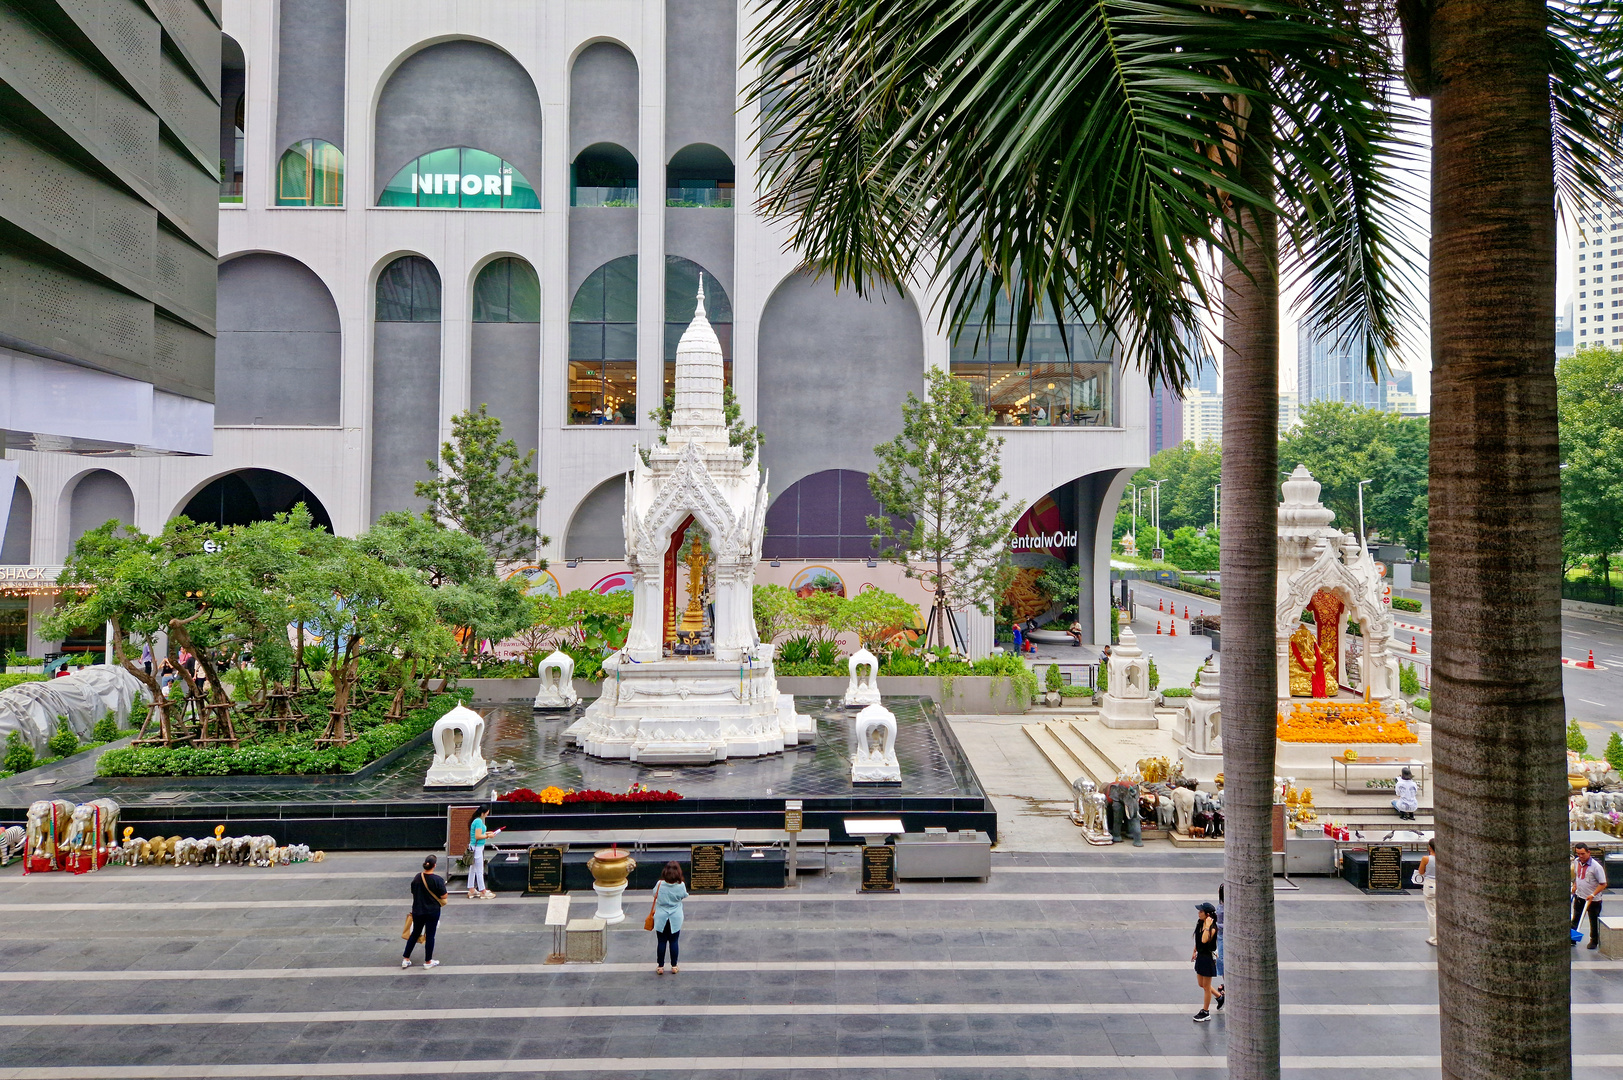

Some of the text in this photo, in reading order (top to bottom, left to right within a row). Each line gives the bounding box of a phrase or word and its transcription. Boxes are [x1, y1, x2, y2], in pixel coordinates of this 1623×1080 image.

[412, 173, 512, 196] NITORI
[1011, 531, 1078, 549] entralwOrld
[0, 567, 46, 580] SHACK
